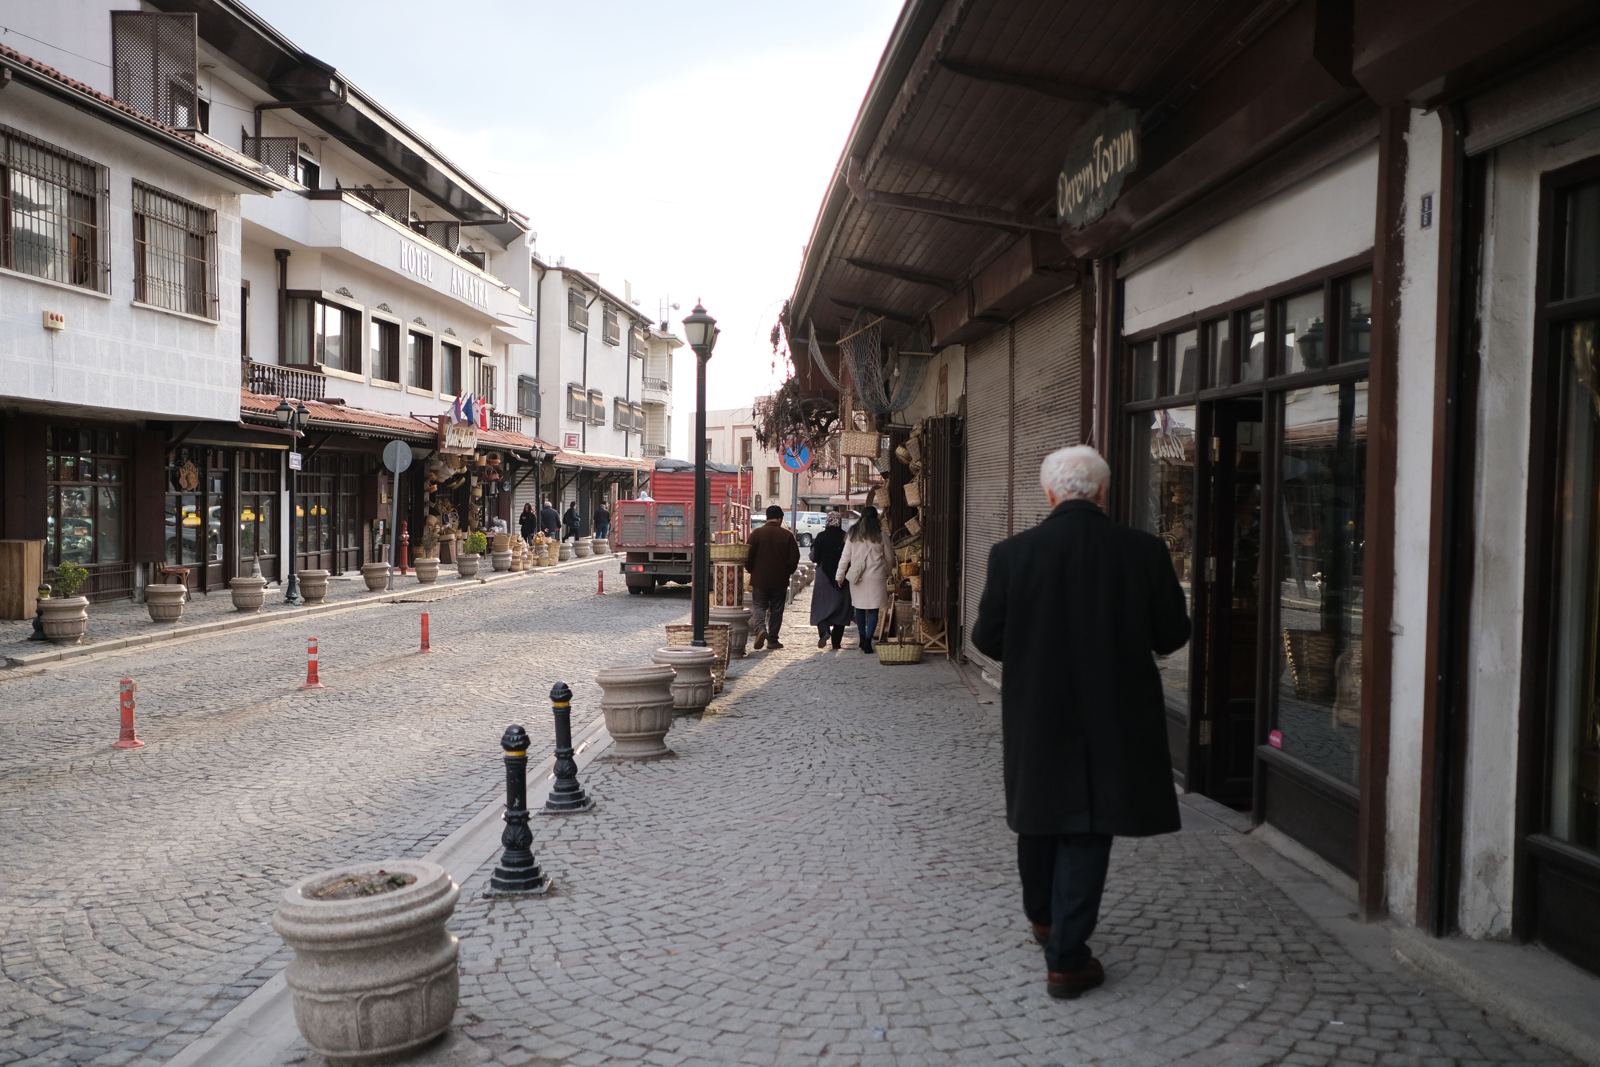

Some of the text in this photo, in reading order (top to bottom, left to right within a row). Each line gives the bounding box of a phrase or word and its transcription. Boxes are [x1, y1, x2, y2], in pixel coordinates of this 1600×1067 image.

[1093, 128, 1134, 188] Torun
[400, 240, 433, 283] HOTEL
[567, 435, 576, 447] E
